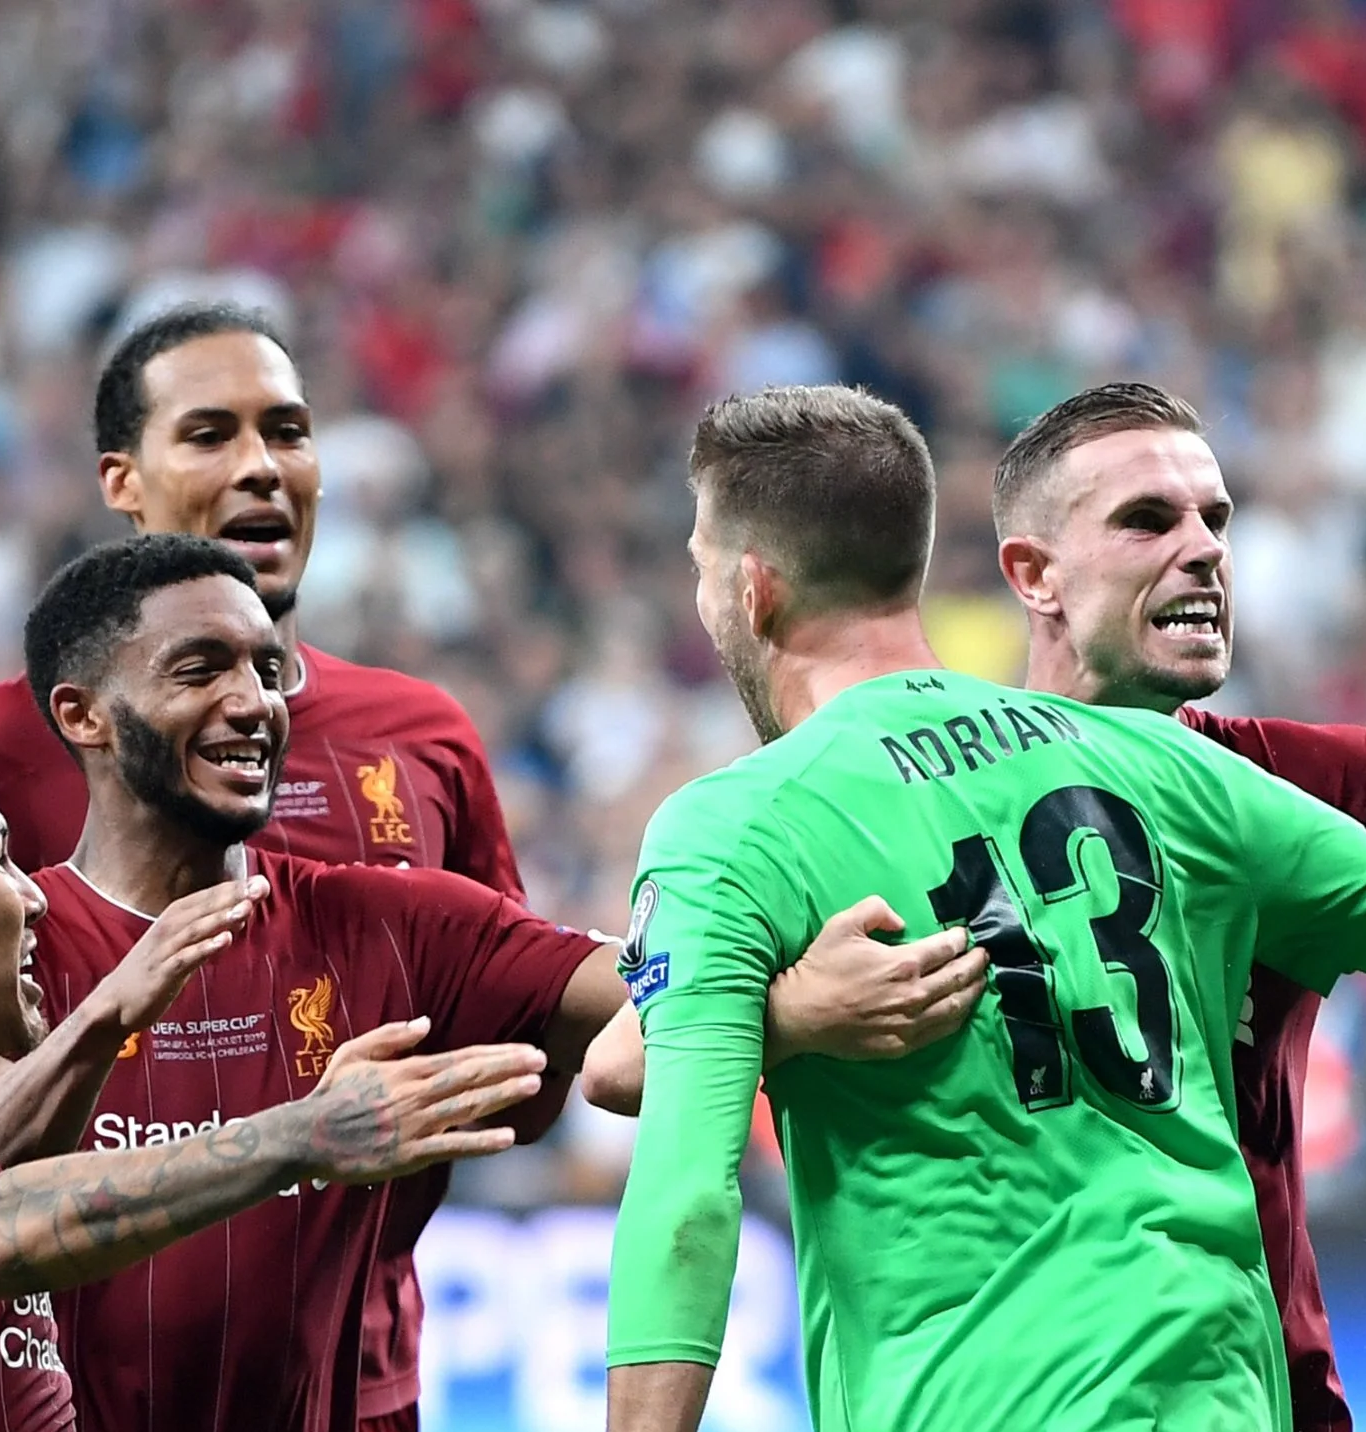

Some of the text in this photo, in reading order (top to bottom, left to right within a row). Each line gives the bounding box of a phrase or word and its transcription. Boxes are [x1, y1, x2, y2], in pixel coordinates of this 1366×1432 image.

[880, 698, 1081, 784] ADRIÁN
[927, 785, 1182, 1113] 13
[151, 1021, 184, 1035] UEFA
[186, 1018, 229, 1034] SUPER
